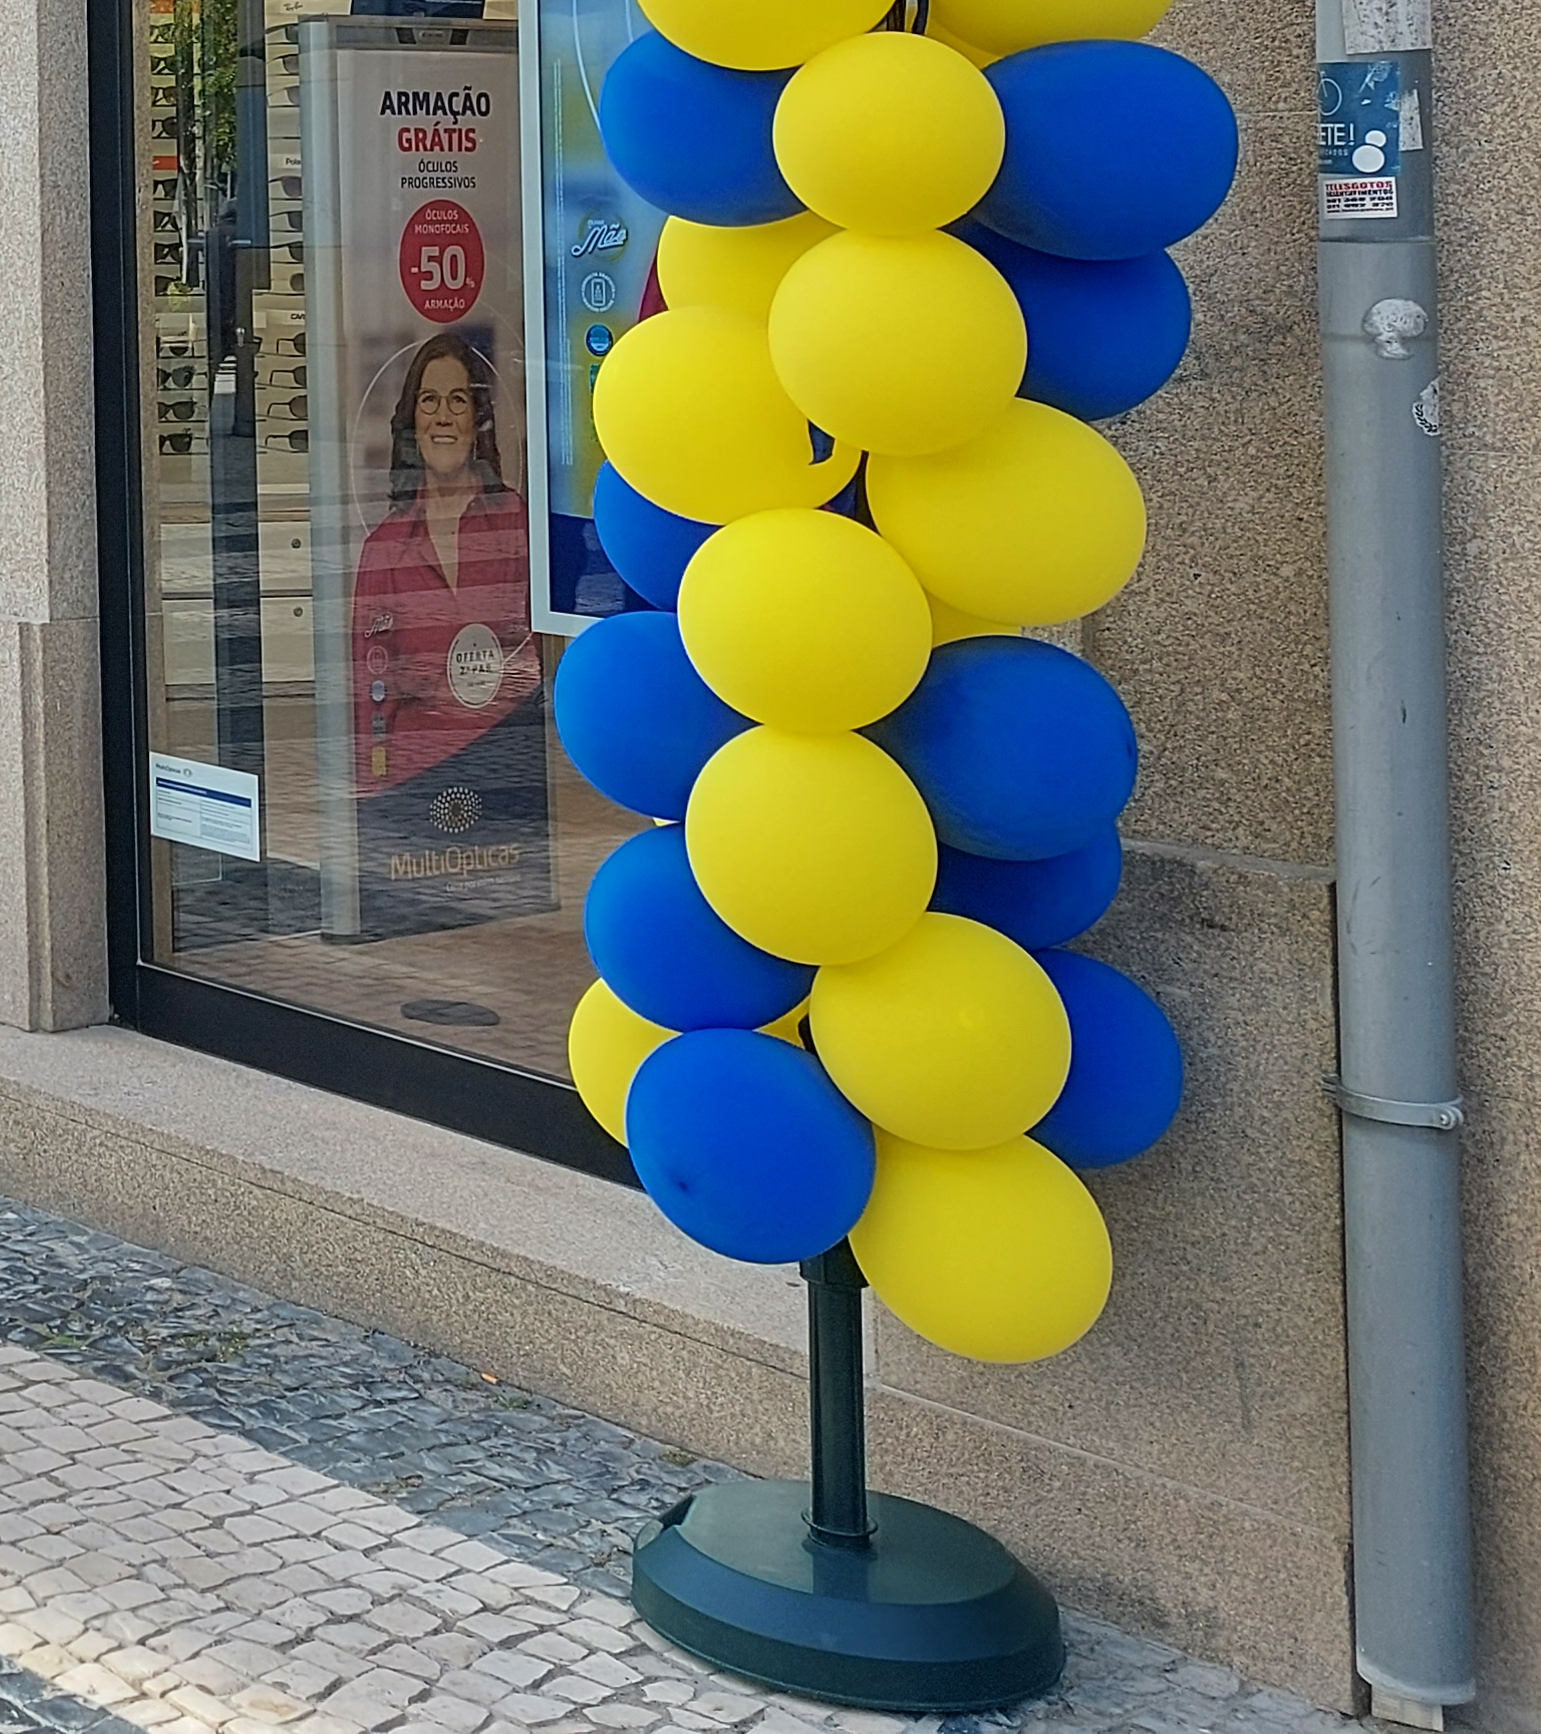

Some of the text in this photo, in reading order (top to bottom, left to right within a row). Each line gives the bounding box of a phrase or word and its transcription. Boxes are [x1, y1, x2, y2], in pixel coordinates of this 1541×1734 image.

[380, 85, 491, 125] ARMAÇÃO
[398, 121, 477, 153] GRÁTIS
[418, 159, 458, 173] ÓCULOS
[401, 176, 476, 188] PROGRESSIVOS
[425, 208, 458, 220] ÓCULOS
[414, 224, 469, 234] MONOFOCAIS
[424, 297, 466, 311] ARMAÇÃO
[455, 651, 496, 663] OFERTA
[390, 844, 524, 882] MultiOpticas
